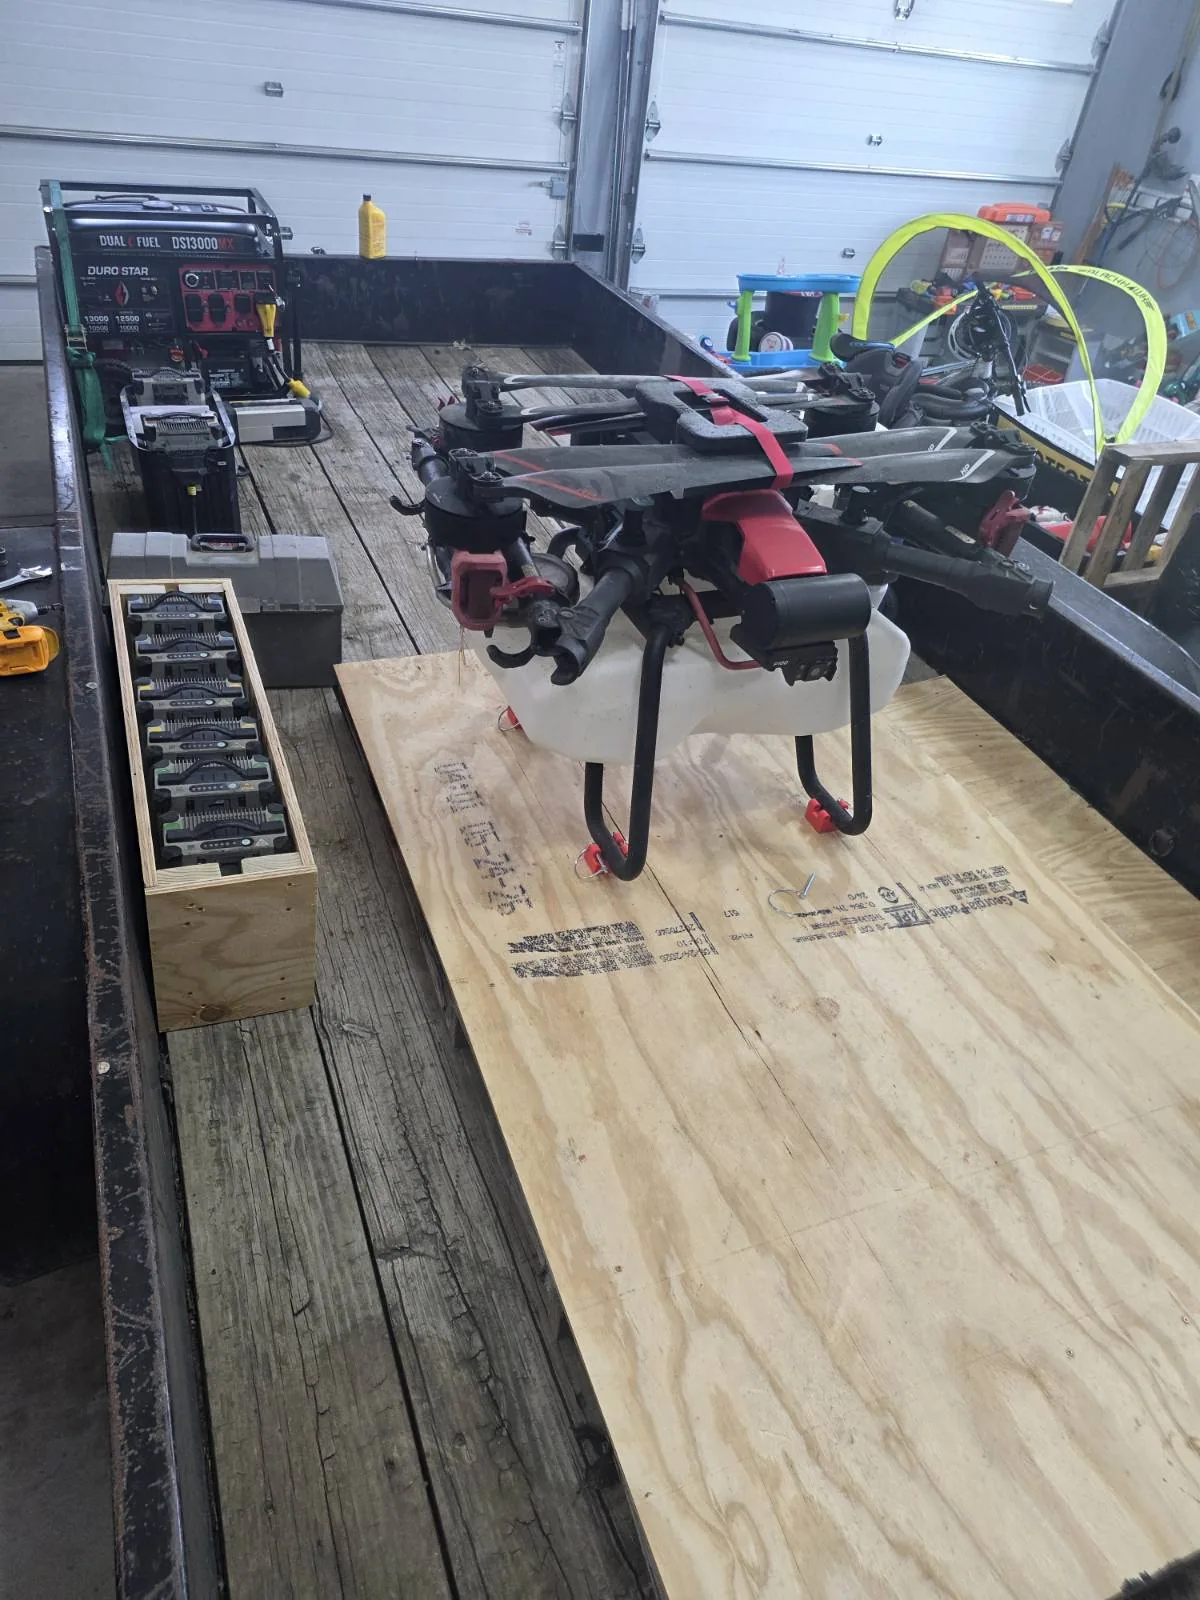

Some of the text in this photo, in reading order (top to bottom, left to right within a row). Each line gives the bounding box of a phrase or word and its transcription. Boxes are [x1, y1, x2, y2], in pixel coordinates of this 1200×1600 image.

[100, 235, 161, 248] DUAL FUEL
[172, 236, 233, 249] DS13000MX
[87, 266, 149, 276] DURO STAR
[960, 463, 970, 476] HP
[889, 908, 920, 924] APA
